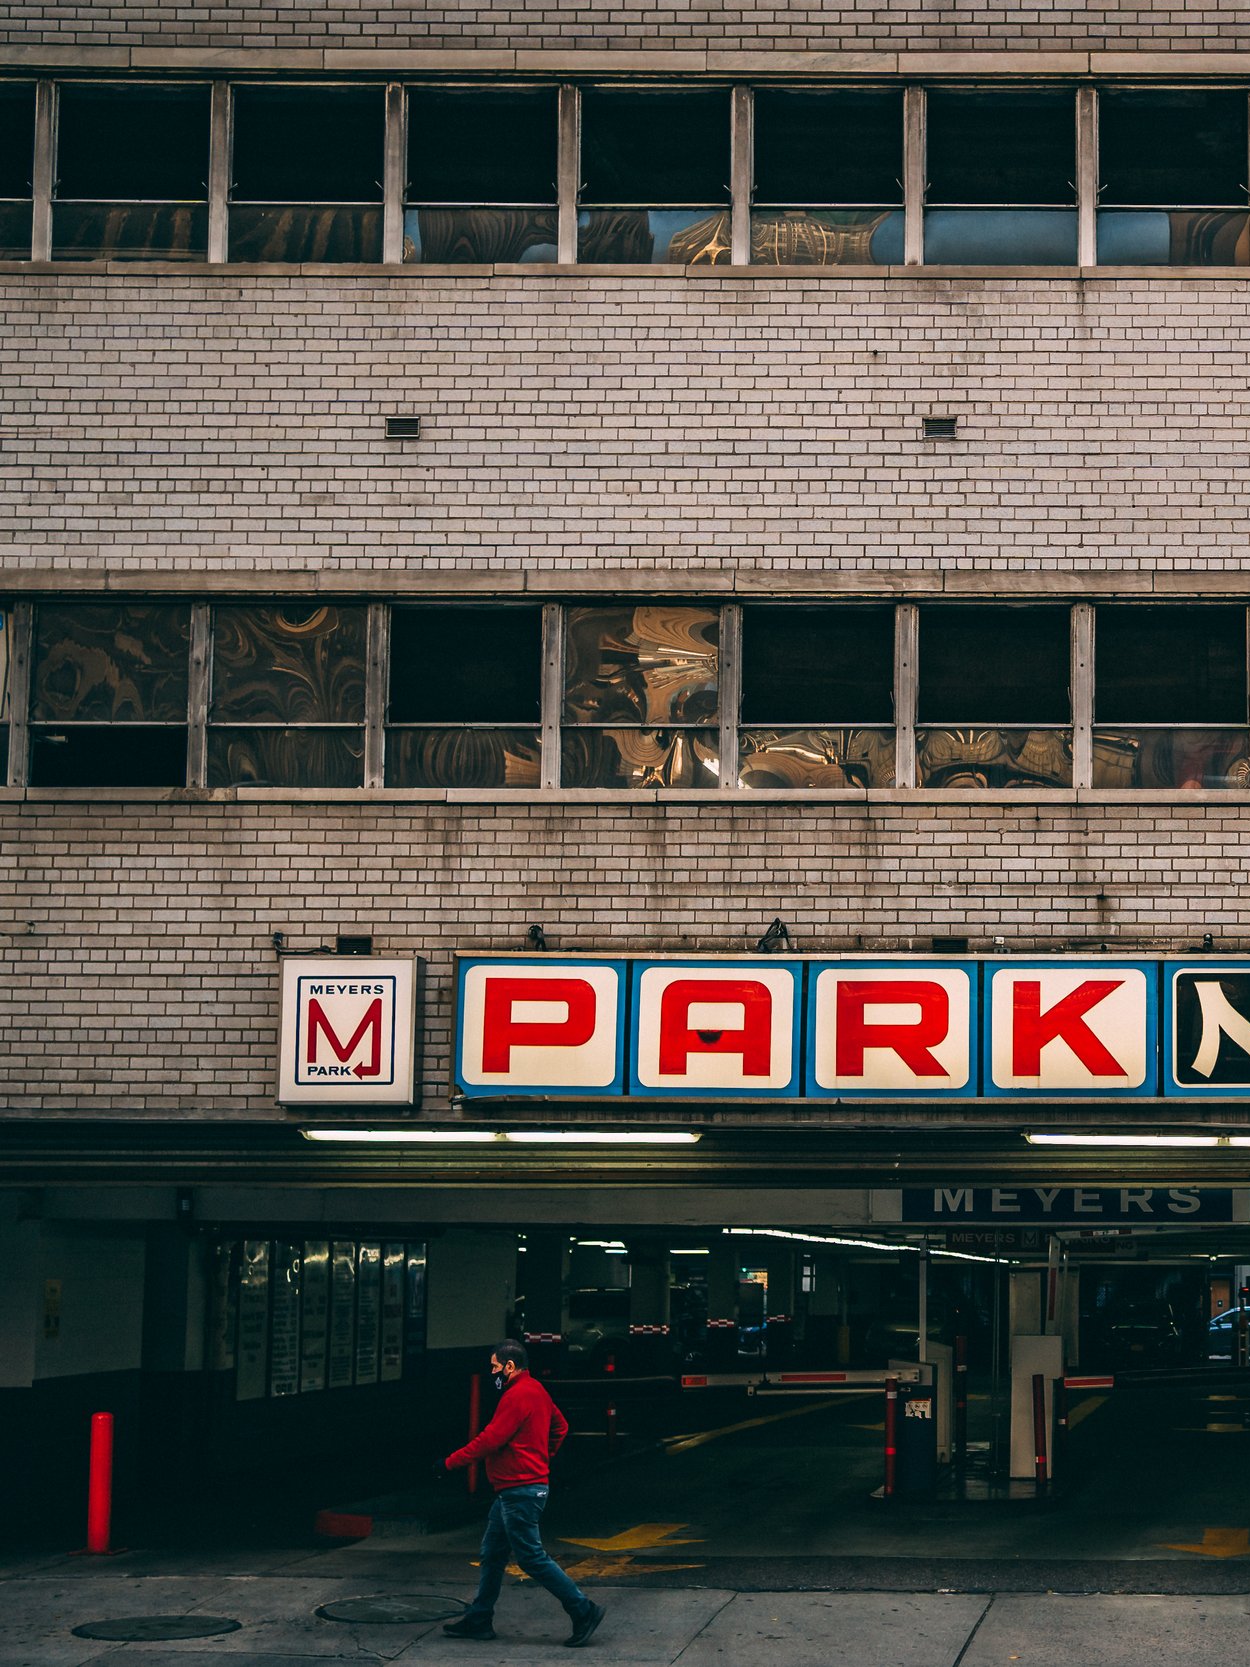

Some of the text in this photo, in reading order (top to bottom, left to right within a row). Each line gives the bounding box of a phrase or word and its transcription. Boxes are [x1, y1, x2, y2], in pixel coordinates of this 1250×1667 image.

[310, 984, 384, 995] MEYERS
[481, 977, 1128, 1077] PARK
[307, 1066, 351, 1075] PARK
[933, 1188, 1202, 1213] MEYERS
